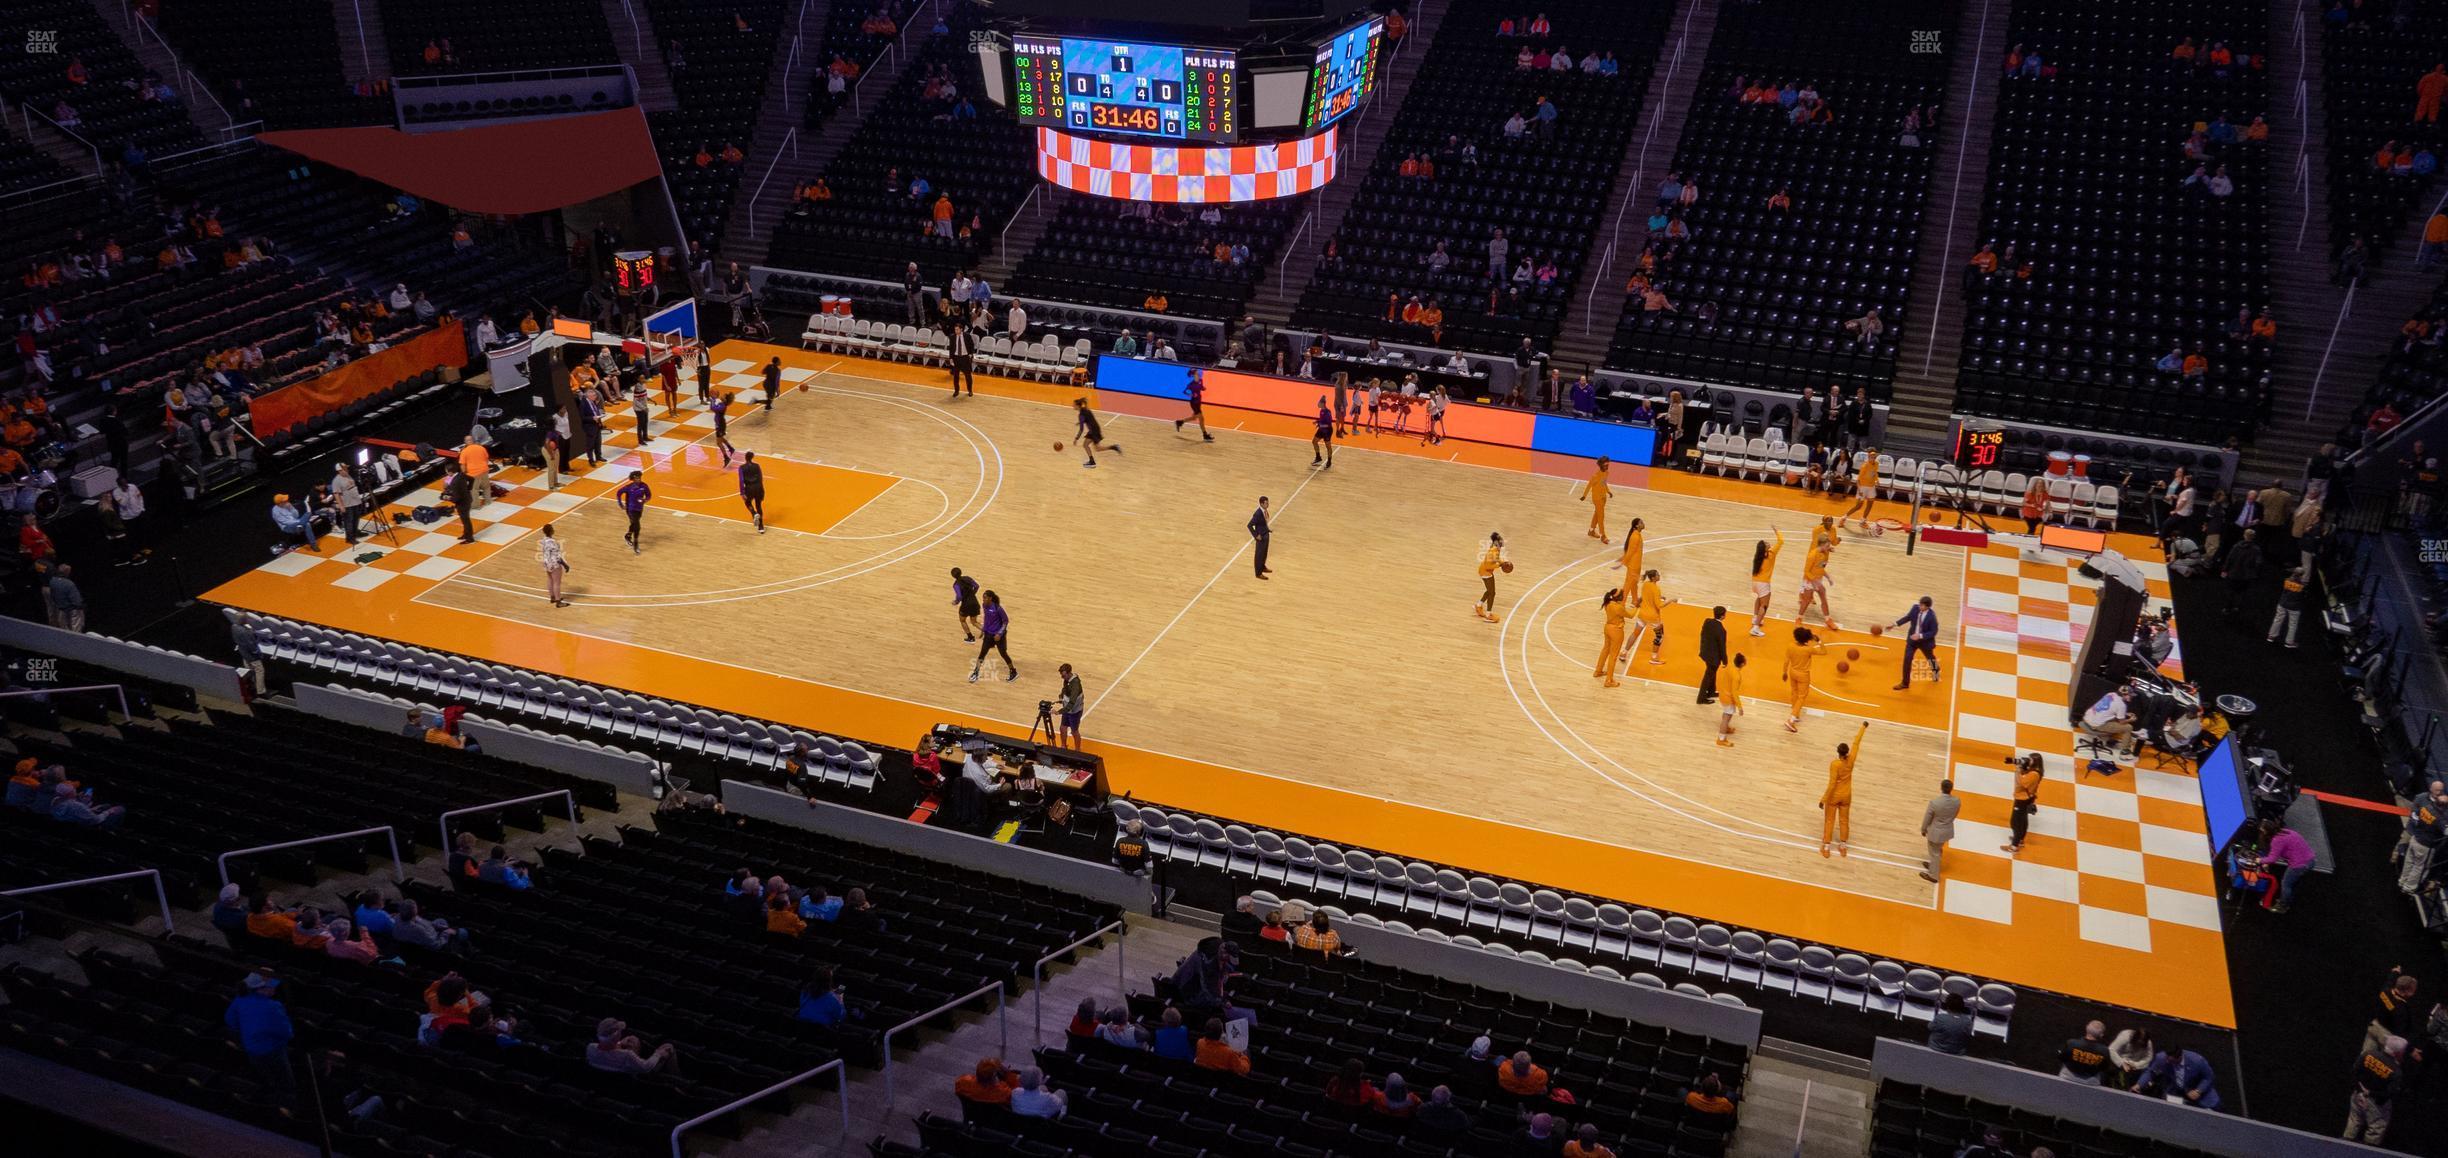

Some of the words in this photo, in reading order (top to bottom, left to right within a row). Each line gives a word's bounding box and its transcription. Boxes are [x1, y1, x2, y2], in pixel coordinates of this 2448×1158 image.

[1014, 43, 1028, 53] PLR
[1031, 44, 1044, 54] FLS
[1047, 46, 1061, 55] PTS
[1016, 58, 1029, 67] 00
[1036, 58, 1040, 67] 1
[1051, 60, 1058, 69] 9
[1120, 58, 1126, 71] 1
[1185, 57, 1200, 66] PLR
[1203, 58, 1217, 68] FLS
[1220, 60, 1235, 69] PTS
[1022, 70, 1026, 79] 1
[1036, 71, 1042, 80] 3
[1050, 72, 1062, 81] 17
[1189, 72, 1196, 81] 3
[1208, 72, 1214, 82] 0
[1223, 74, 1230, 83] 0
[1020, 82, 1031, 91] 13
[1038, 83, 1042, 92] 1
[1053, 85, 1060, 93] 8
[1078, 78, 1086, 92] 0
[1187, 84, 1198, 93] 11
[1208, 85, 1215, 94] 0
[1224, 86, 1230, 96] 7
[1103, 87, 1111, 97] 4
[1138, 90, 1145, 100] 4
[1162, 85, 1171, 100] 0
[1020, 95, 1032, 103] 23
[1038, 95, 1043, 104] 1
[1052, 97, 1064, 106] 10
[1072, 102, 1085, 110] FLS
[1187, 96, 1200, 105] 20
[1208, 98, 1215, 106] 2
[1224, 99, 1230, 108] 7
[1020, 106, 1033, 116] 33
[1038, 107, 1045, 116] 0
[1055, 108, 1062, 117] 0
[1165, 110, 1179, 119] FLS
[1187, 109, 1199, 118] 21
[1210, 110, 1215, 119] 1
[1224, 111, 1231, 121] 2
[1076, 114, 1083, 124] 0
[1094, 106, 1157, 130] 31:46
[1168, 122, 1175, 132] 0
[1188, 121, 1200, 130] 24
[1209, 122, 1216, 131] 0
[1225, 124, 1231, 133] 0
[640, 267, 652, 286] 30
[1969, 433, 2002, 445] 31:46
[1971, 446, 1996, 465] 30
[1120, 843, 1142, 851] EVENT
